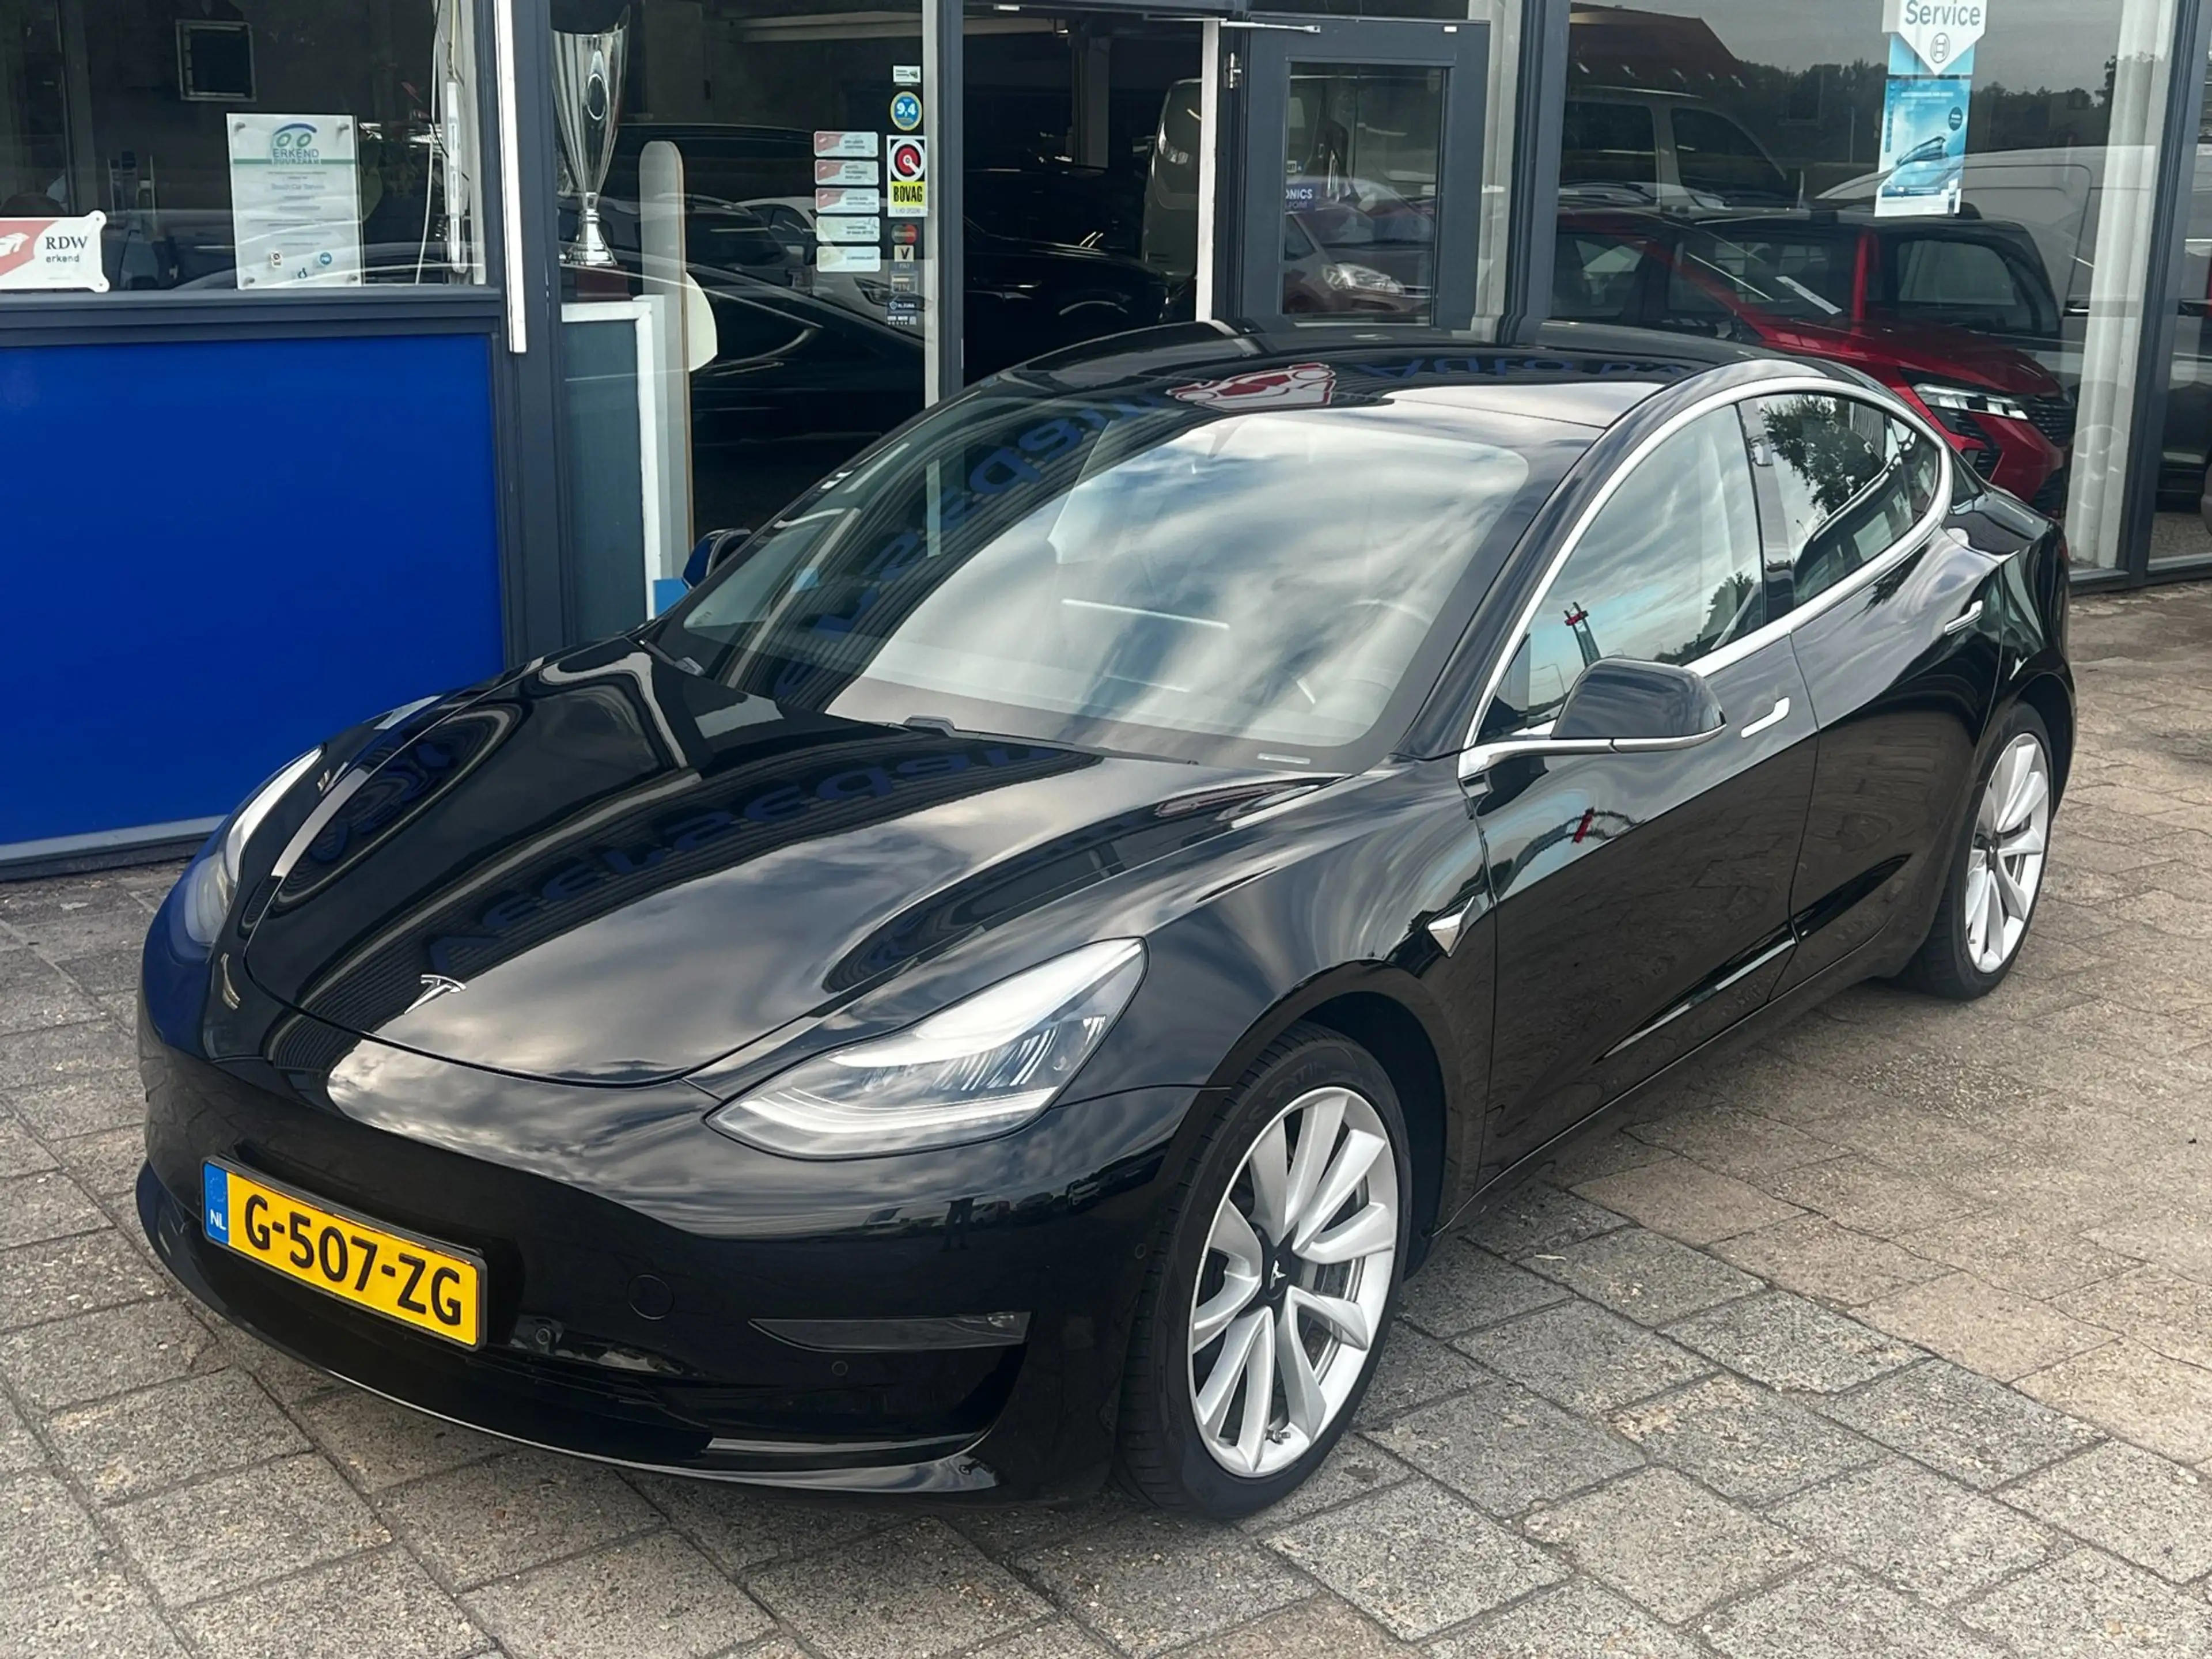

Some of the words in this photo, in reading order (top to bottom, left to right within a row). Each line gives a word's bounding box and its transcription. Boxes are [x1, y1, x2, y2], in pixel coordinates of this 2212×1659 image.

[1905, 0, 1982, 25] Service
[272, 149, 319, 158] ERKEND
[893, 185, 922, 202] BOVAG
[46, 236, 88, 249] RDW
[46, 255, 79, 263] erkend
[900, 247, 910, 259] V
[209, 1209, 227, 1230] NL
[245, 1194, 461, 1326] G-507-ZG
